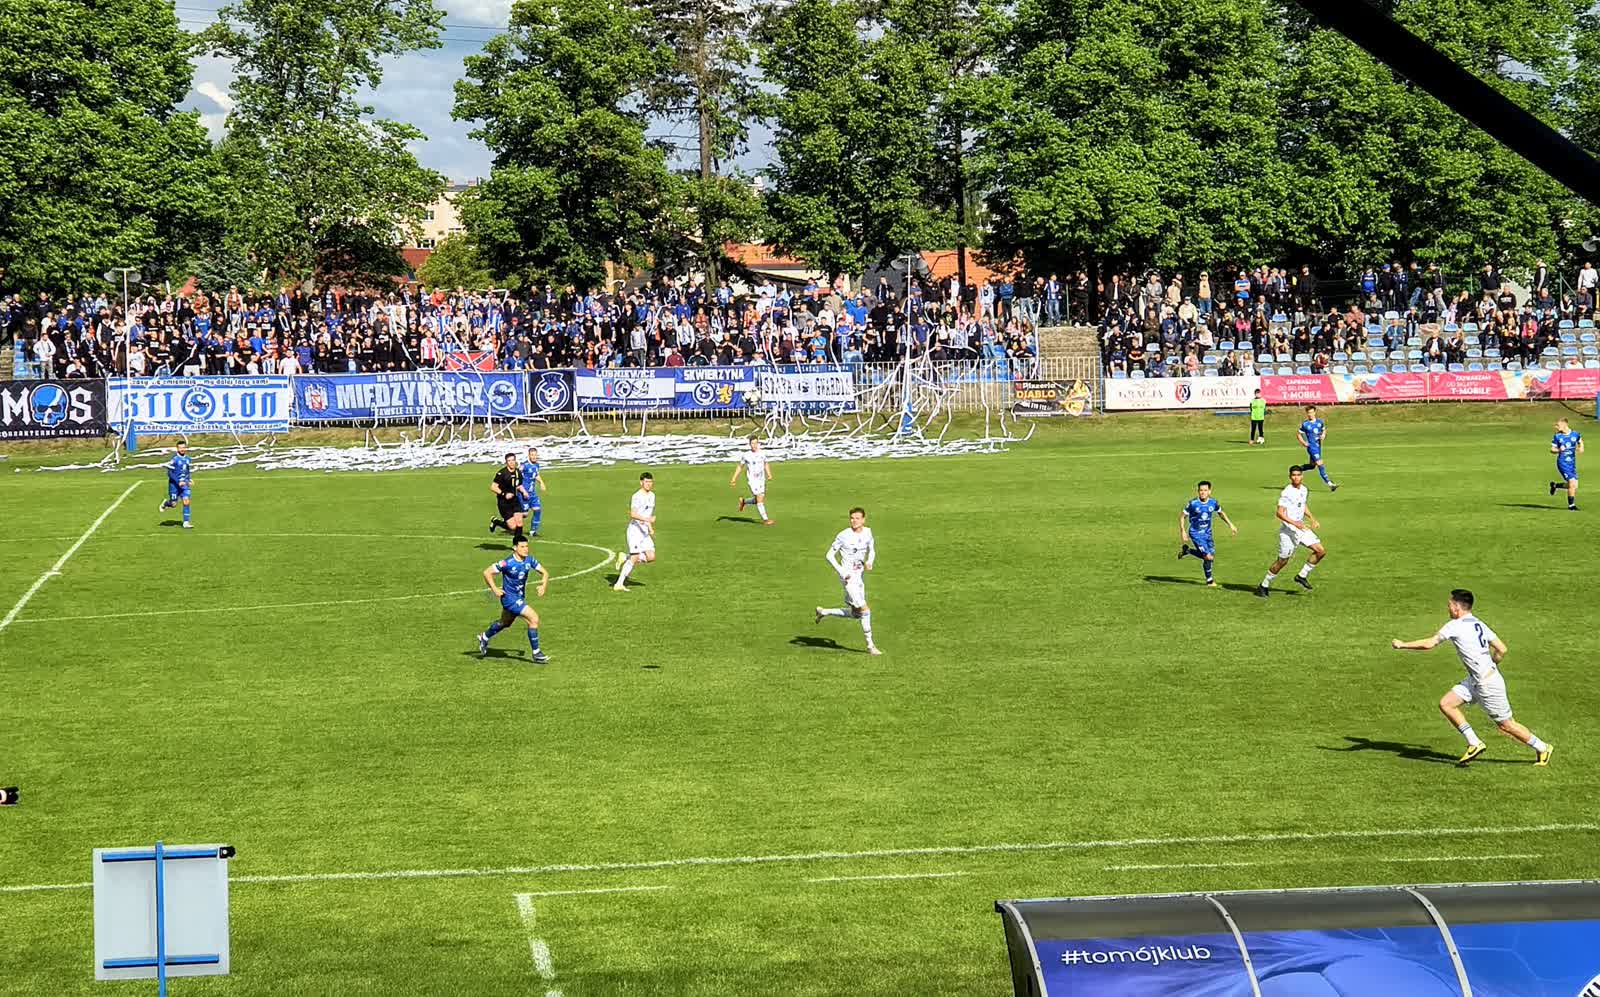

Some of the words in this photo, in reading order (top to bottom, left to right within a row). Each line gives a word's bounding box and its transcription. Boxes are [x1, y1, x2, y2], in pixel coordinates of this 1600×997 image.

[684, 369, 745, 380] SKWIERZYNA
[1016, 390, 1057, 399] DIABLO
[1474, 623, 1486, 648] 2
[1061, 945, 1211, 966] #tomójklub
